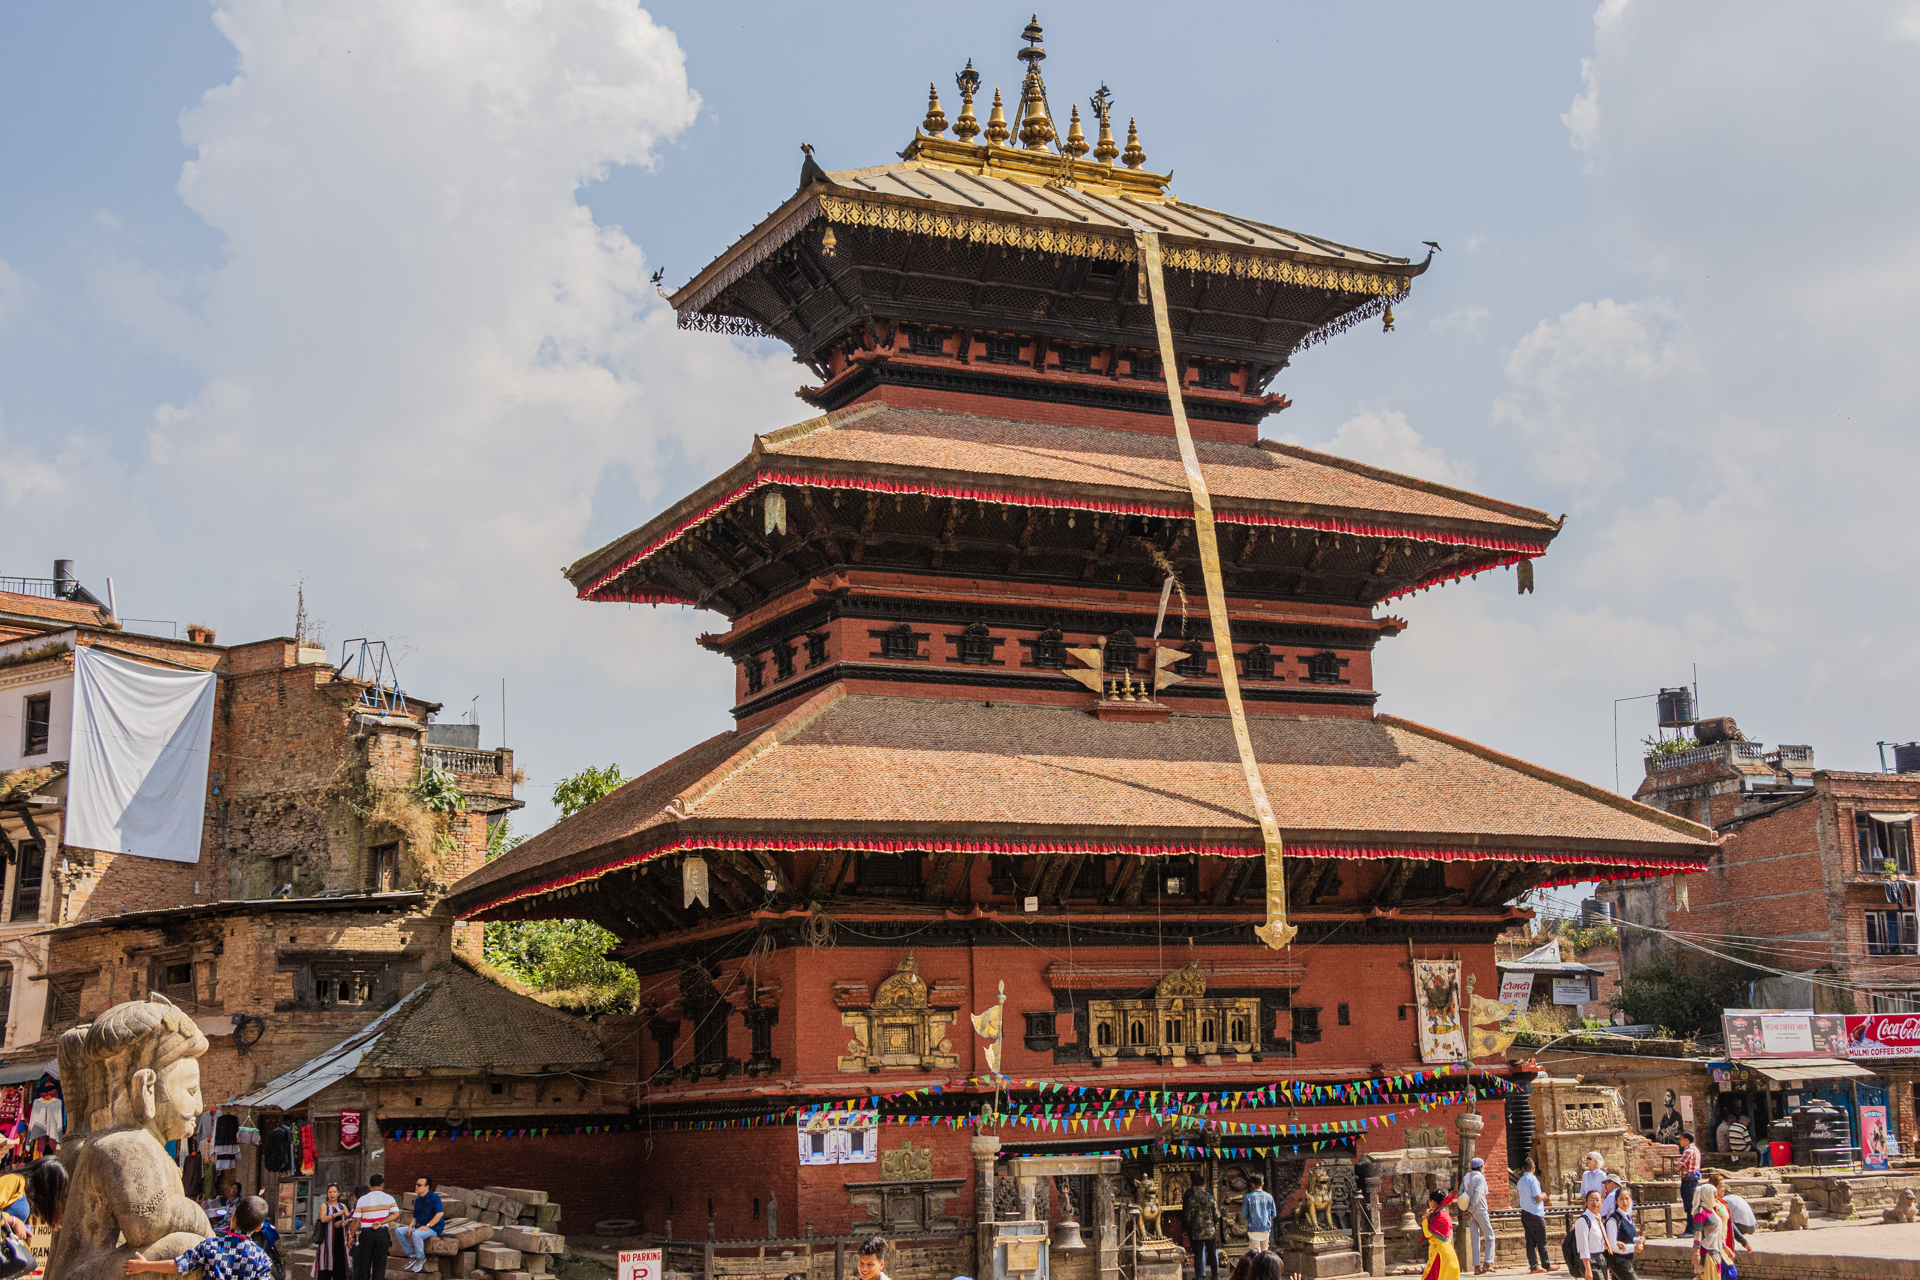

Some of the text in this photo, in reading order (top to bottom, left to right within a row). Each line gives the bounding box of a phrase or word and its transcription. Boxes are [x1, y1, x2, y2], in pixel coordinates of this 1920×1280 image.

[1779, 1023, 1795, 1031] COFFEE
[1796, 1023, 1808, 1031] SHOP
[1877, 1017, 1920, 1040] Coca-Cola
[1849, 1049, 1869, 1057] MULMI
[1870, 1048, 1895, 1056] COFFEE
[1896, 1047, 1913, 1055] SHOP
[621, 1252, 661, 1262] NO PARKING
